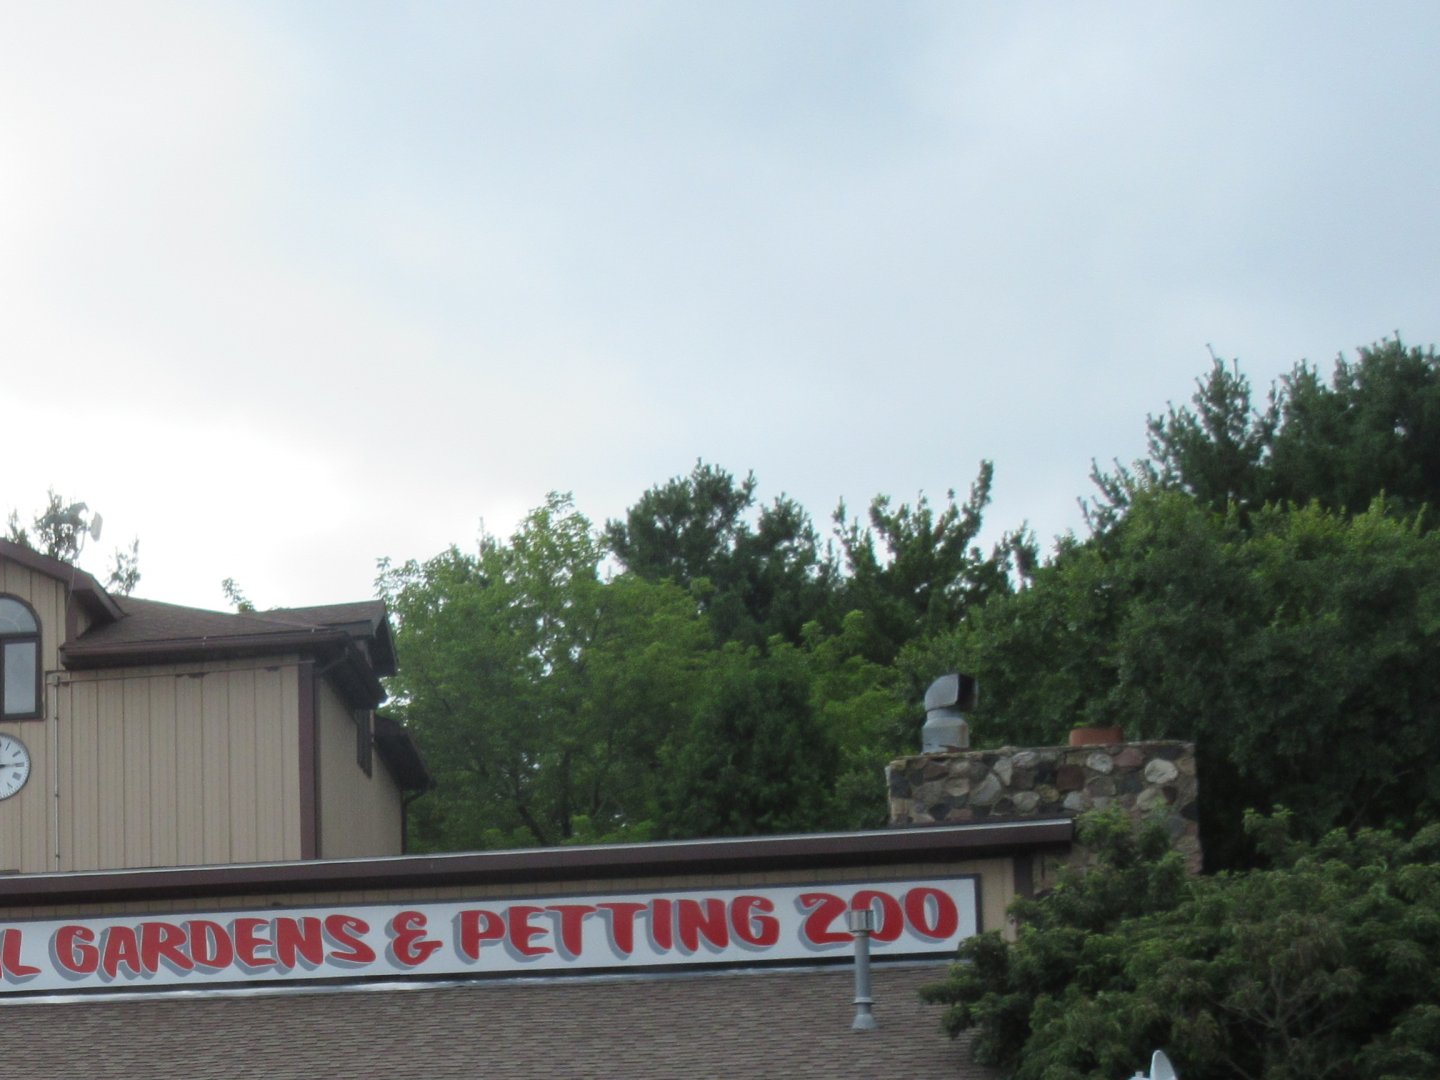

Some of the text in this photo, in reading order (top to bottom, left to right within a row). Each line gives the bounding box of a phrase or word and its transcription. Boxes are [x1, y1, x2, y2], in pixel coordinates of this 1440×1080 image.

[52, 914, 376, 979] GARDENS
[388, 910, 443, 966] &
[457, 895, 780, 962] PETTING
[800, 887, 959, 945] ZOO
